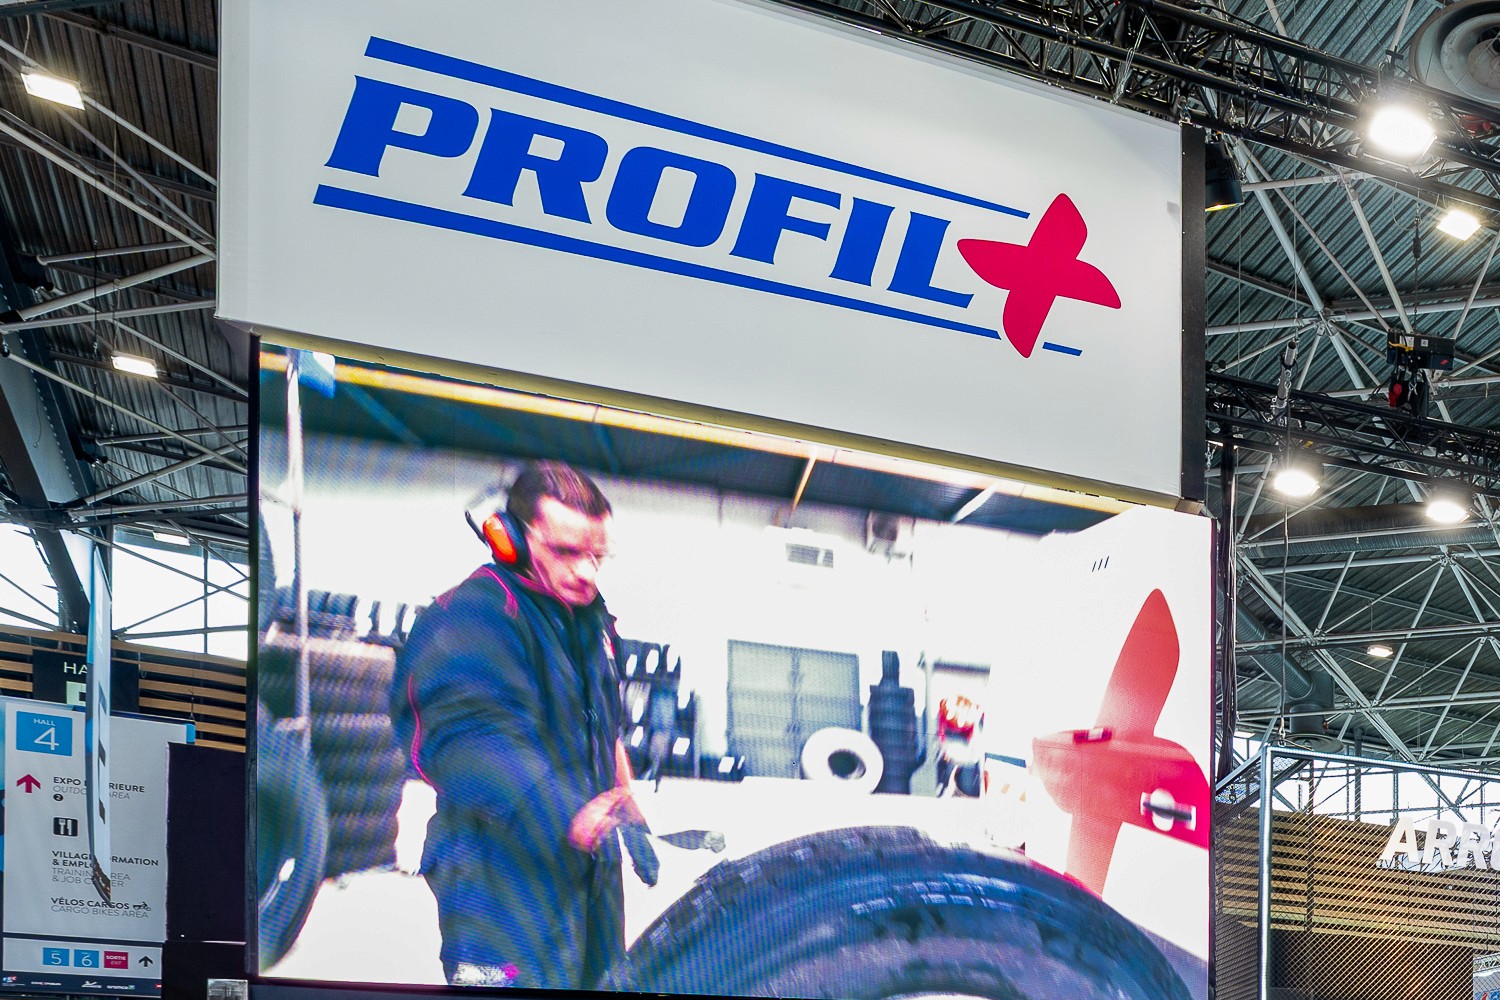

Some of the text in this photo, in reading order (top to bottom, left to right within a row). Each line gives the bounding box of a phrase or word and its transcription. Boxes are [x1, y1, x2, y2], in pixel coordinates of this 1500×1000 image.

[34, 718, 56, 727] HALL
[34, 727, 59, 750] 4
[53, 776, 81, 786] EXPO
[52, 867, 93, 877] TRAININ
[62, 876, 82, 885] JOB
[51, 896, 85, 907] VÉLOS
[51, 905, 149, 919] CARGO BIKES AREA
[51, 953, 93, 967] 5 6
